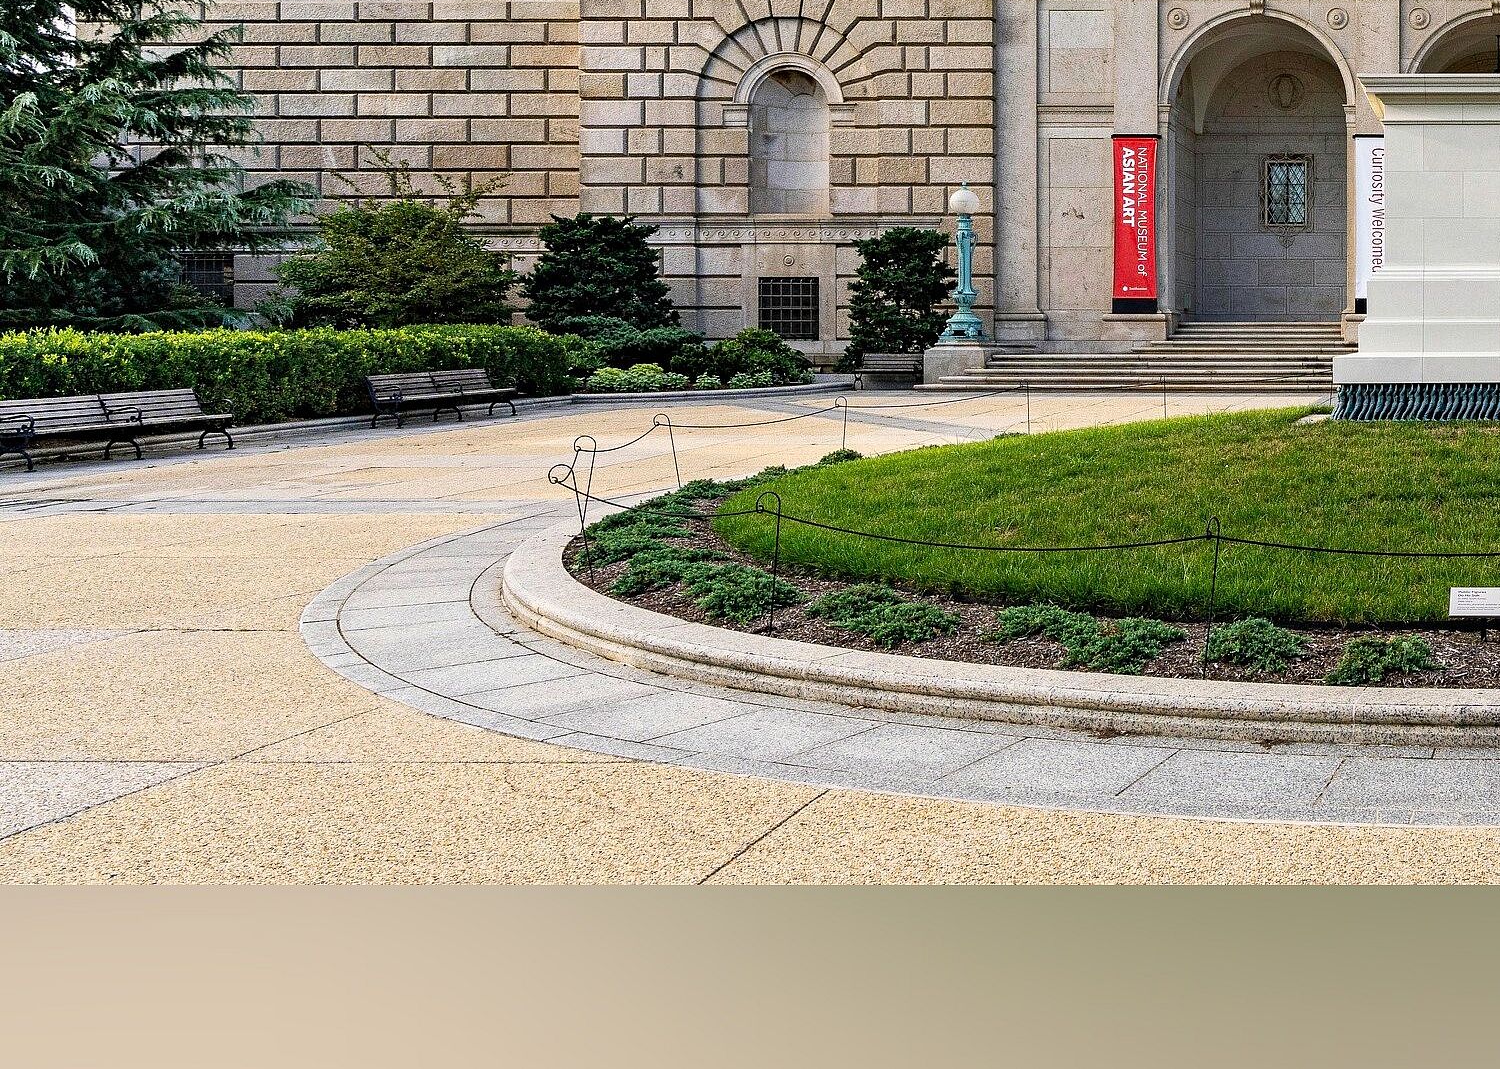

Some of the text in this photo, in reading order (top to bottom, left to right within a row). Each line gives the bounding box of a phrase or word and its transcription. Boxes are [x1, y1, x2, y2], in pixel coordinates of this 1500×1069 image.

[1122, 147, 1136, 227] ASIAN ART
[1137, 147, 1148, 206] NATIONAL
[1368, 147, 1385, 205] Curiosity
[1137, 211, 1148, 261] MUSEUM
[1137, 264, 1148, 277] of
